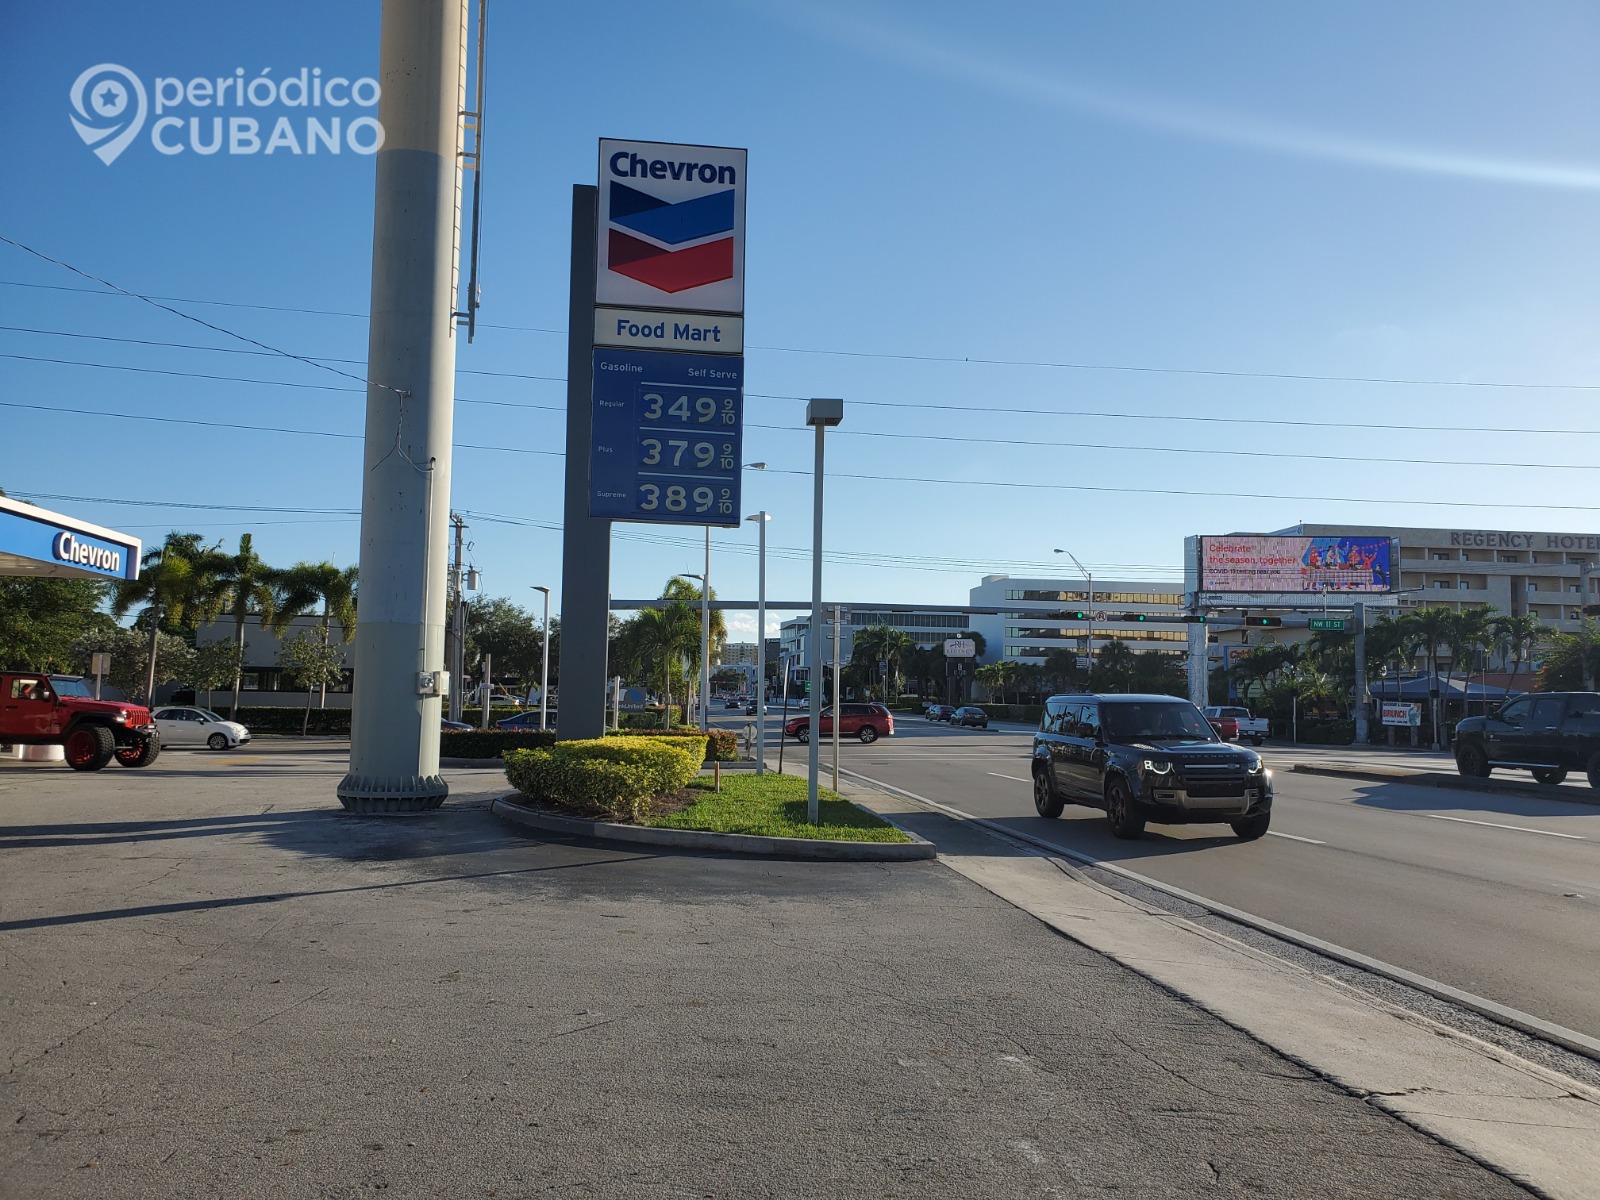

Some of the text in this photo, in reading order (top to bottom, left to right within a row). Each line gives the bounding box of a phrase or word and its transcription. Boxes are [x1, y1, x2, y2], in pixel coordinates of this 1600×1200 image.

[609, 151, 736, 185] Chevron
[617, 319, 721, 342] Food Mart
[600, 361, 737, 379] Gasoline Self Serve
[599, 400, 625, 408] Regular
[642, 393, 717, 423] 349
[598, 445, 613, 453] Plus
[640, 438, 715, 468] 379
[596, 490, 627, 499] Supreme
[639, 483, 714, 513] 389
[58, 531, 120, 572] Chevron
[1209, 544, 1251, 553] Celebrate
[1450, 531, 1534, 549] REGENCY
[1209, 556, 1224, 564] the
[1260, 556, 1296, 567] together
